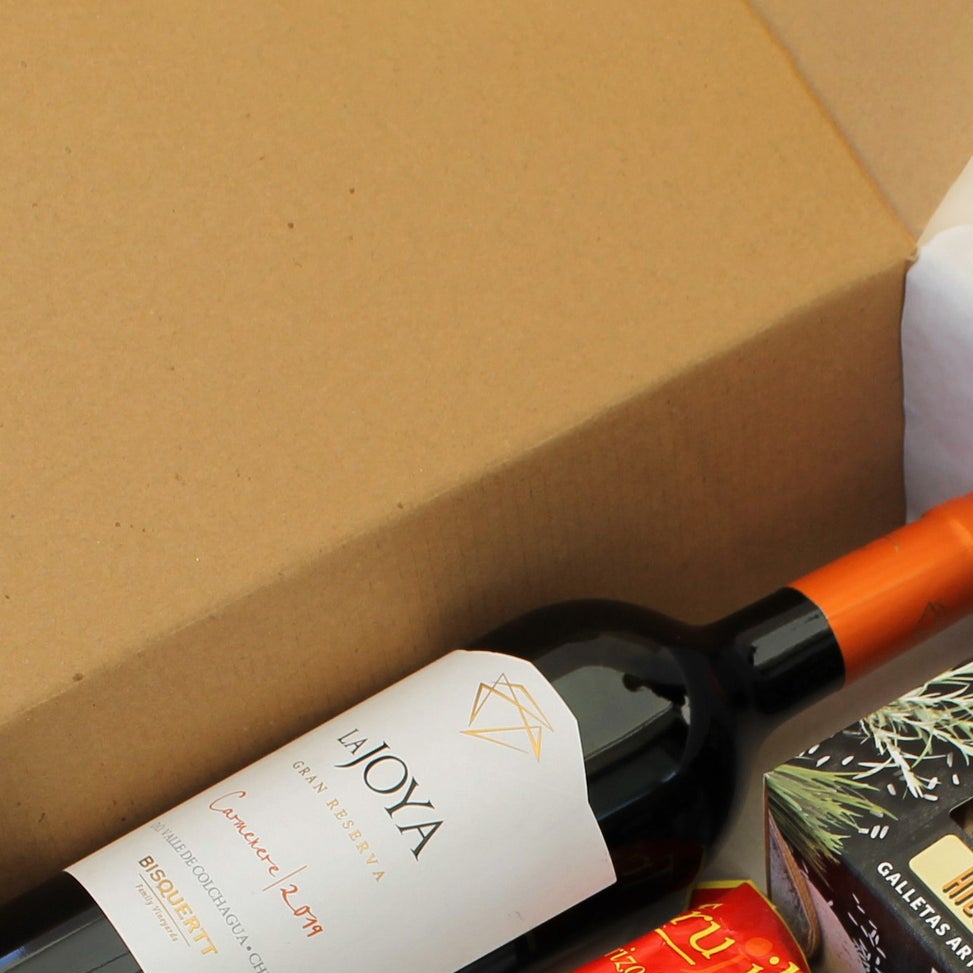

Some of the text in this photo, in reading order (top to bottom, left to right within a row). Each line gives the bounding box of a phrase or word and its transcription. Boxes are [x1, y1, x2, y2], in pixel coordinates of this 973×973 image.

[292, 761, 386, 882] GRAN RESERVA
[334, 728, 444, 861] LA JOYA
[136, 884, 153, 906] Family
[139, 855, 219, 956] BISQUERTT
[161, 828, 185, 858] VALLE
[180, 846, 198, 868] DE
[192, 865, 248, 946] COLCHAGUA
[877, 861, 951, 937] GALLETAS
